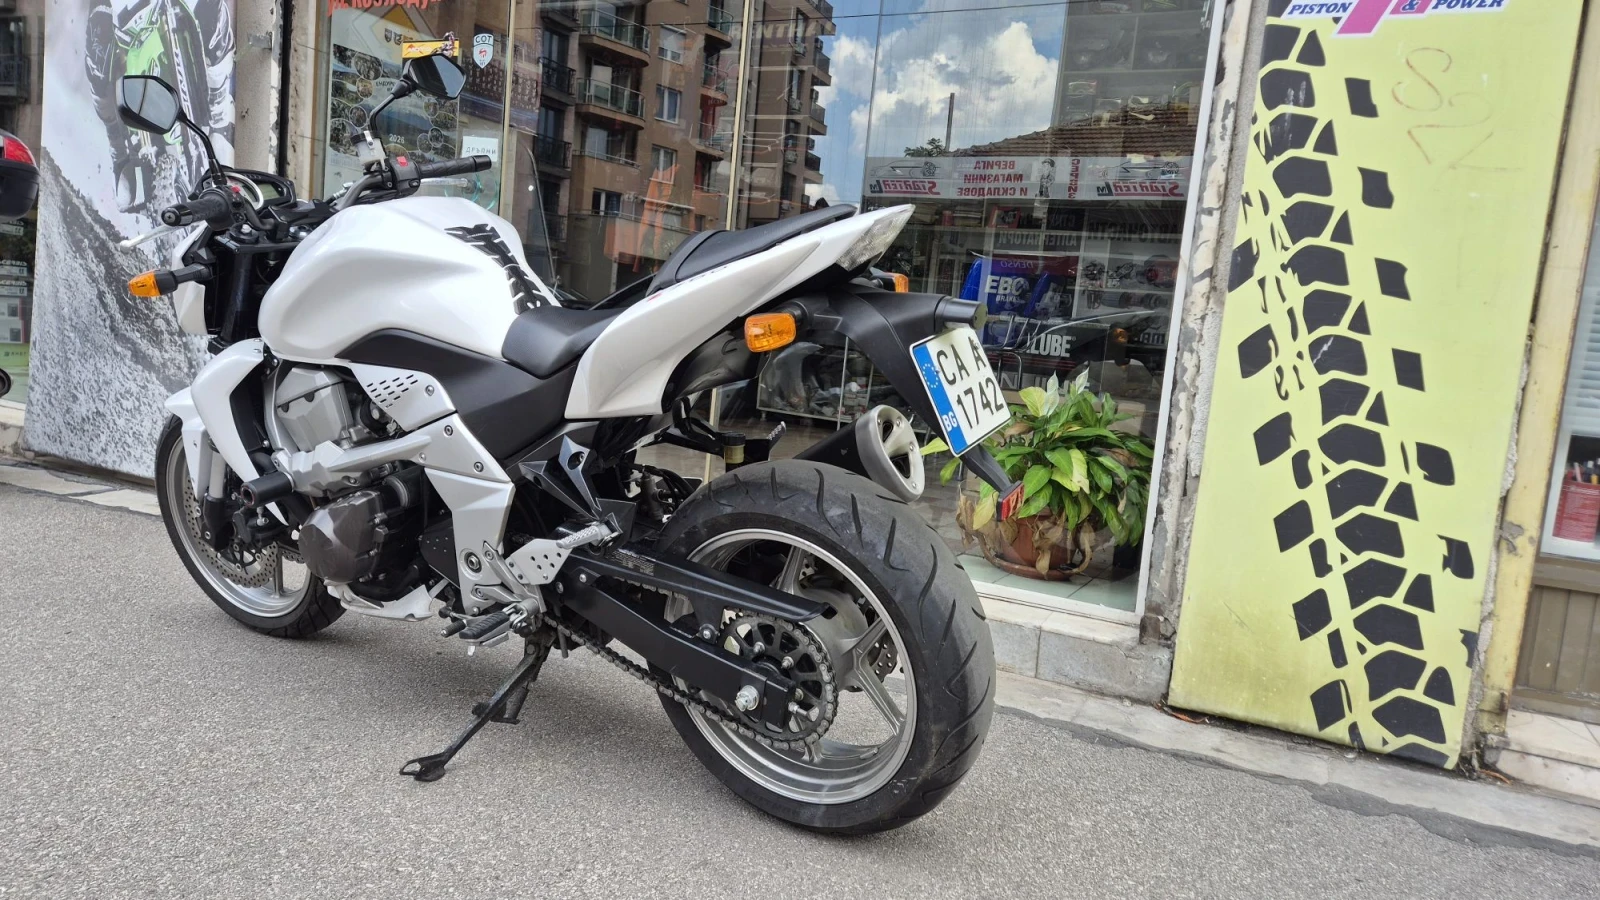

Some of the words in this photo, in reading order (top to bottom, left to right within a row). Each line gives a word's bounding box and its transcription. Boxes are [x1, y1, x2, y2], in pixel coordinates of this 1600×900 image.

[1287, 2, 1353, 15] PISTON
[1401, 0, 1419, 11] &
[1431, 0, 1505, 10] POWER
[984, 274, 1020, 296] EBC
[956, 377, 1004, 430] 1742
[941, 411, 958, 432] BG
